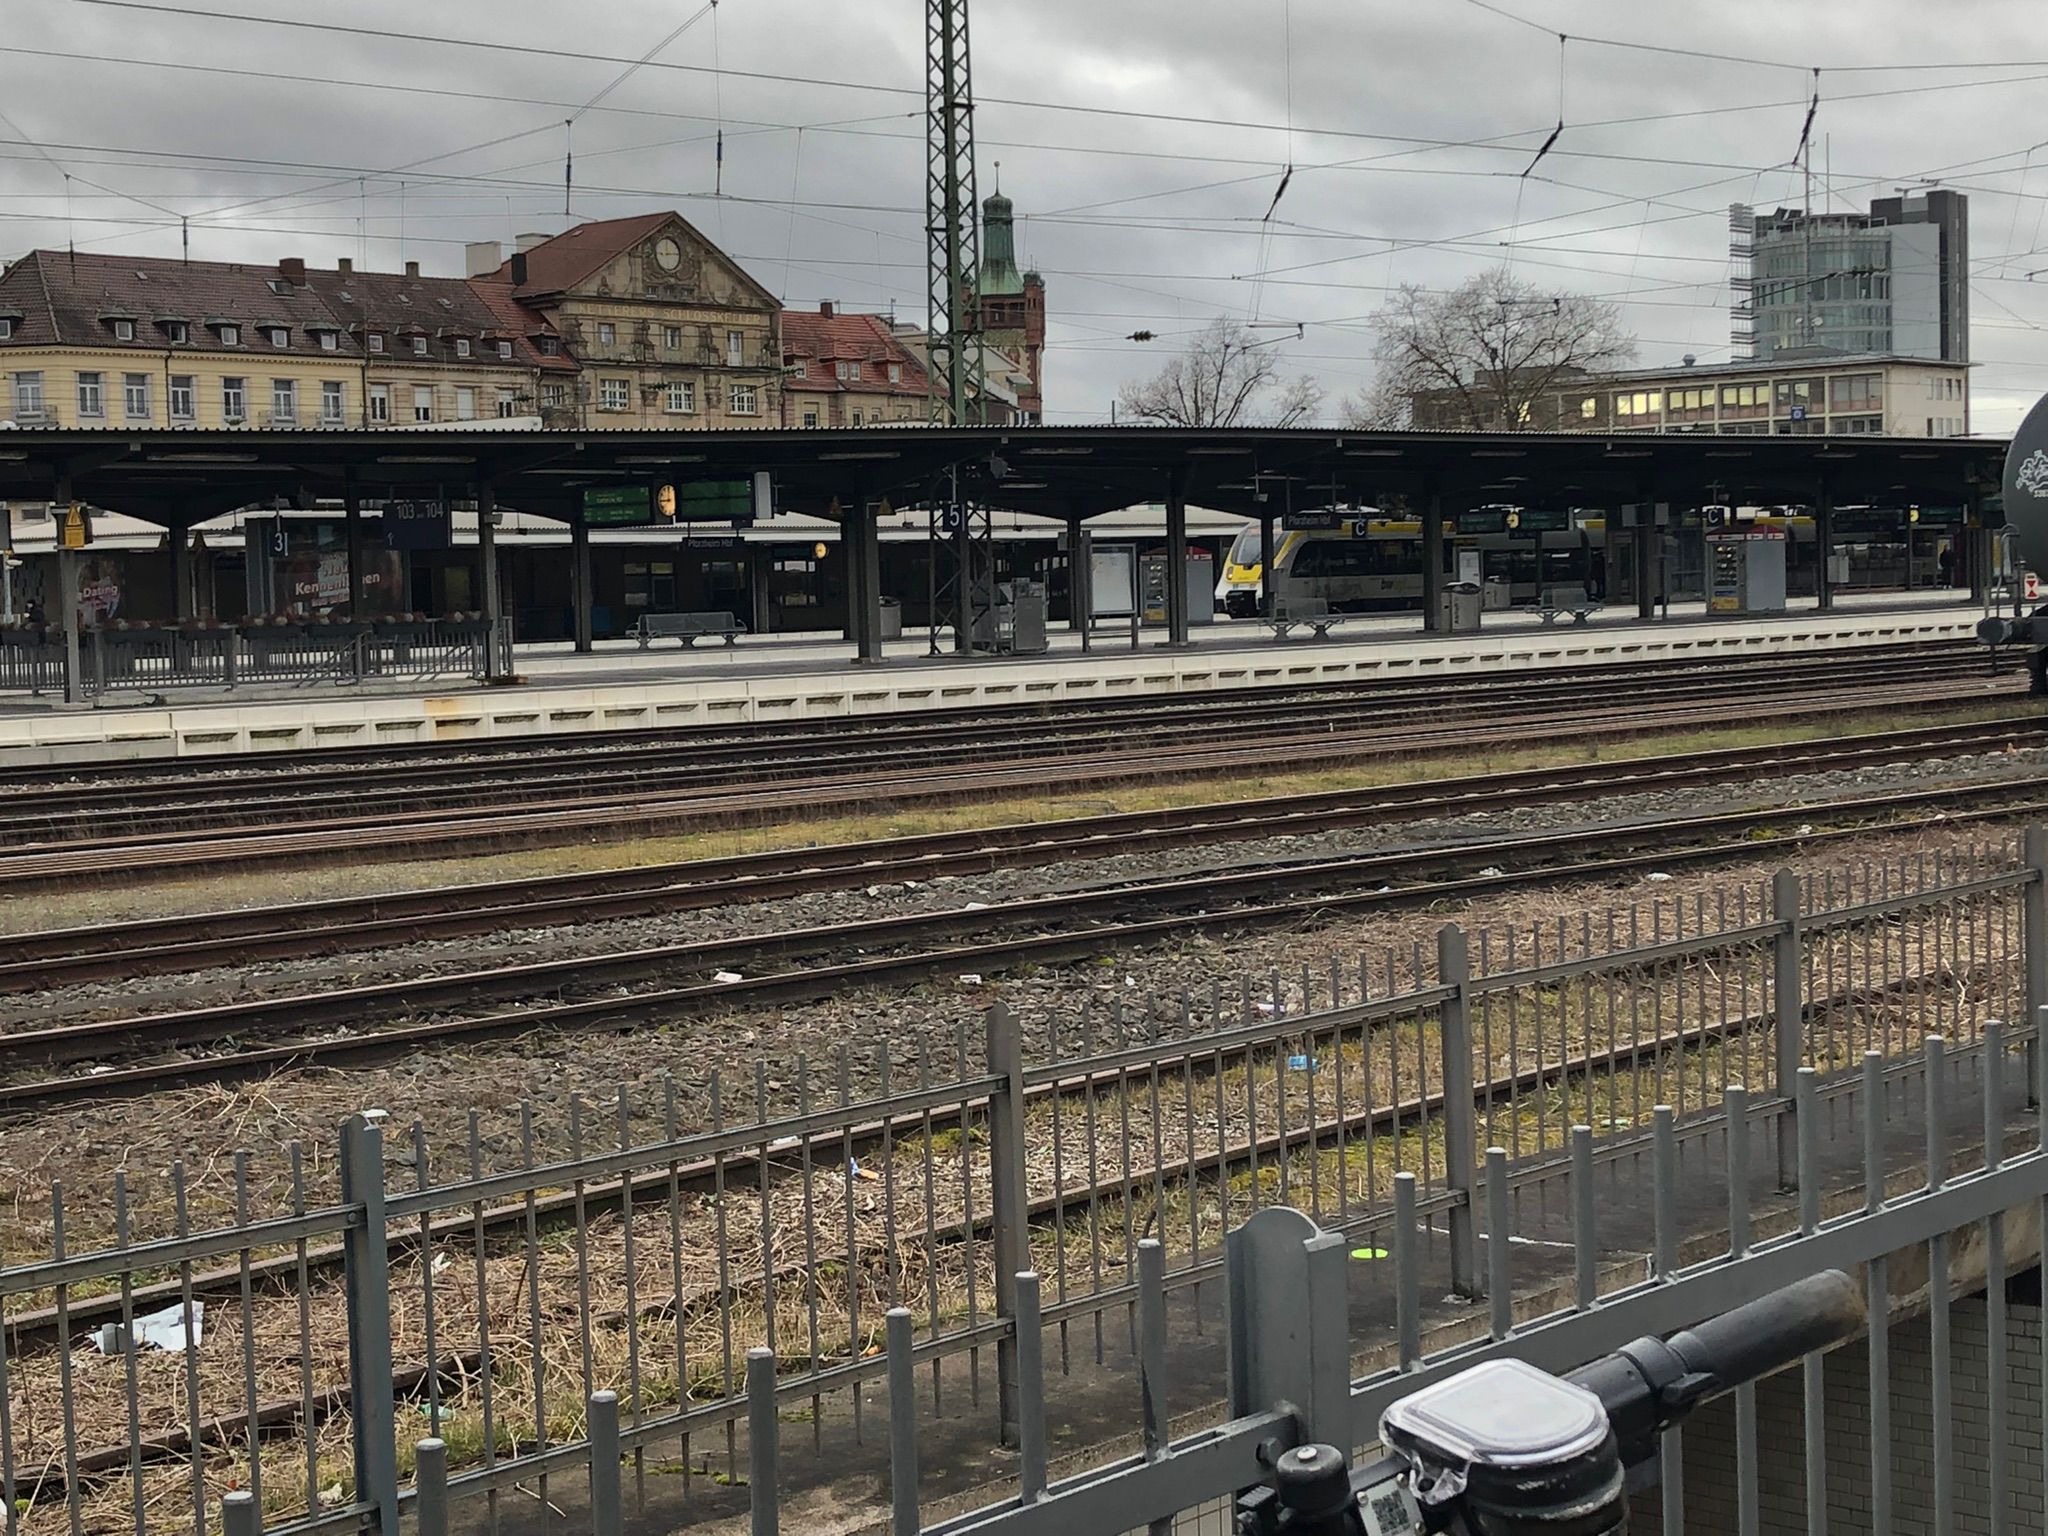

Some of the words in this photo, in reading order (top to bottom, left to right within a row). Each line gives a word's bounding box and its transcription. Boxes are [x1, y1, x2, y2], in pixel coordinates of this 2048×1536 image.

[578, 303, 656, 318] KETTERERS
[662, 308, 762, 325] SCHLOSSKELLER
[396, 503, 415, 520] 103
[425, 501, 444, 519] 104
[949, 503, 961, 527] 5
[1707, 508, 1720, 524] C
[1355, 521, 1365, 536] C
[273, 532, 284, 552] 3
